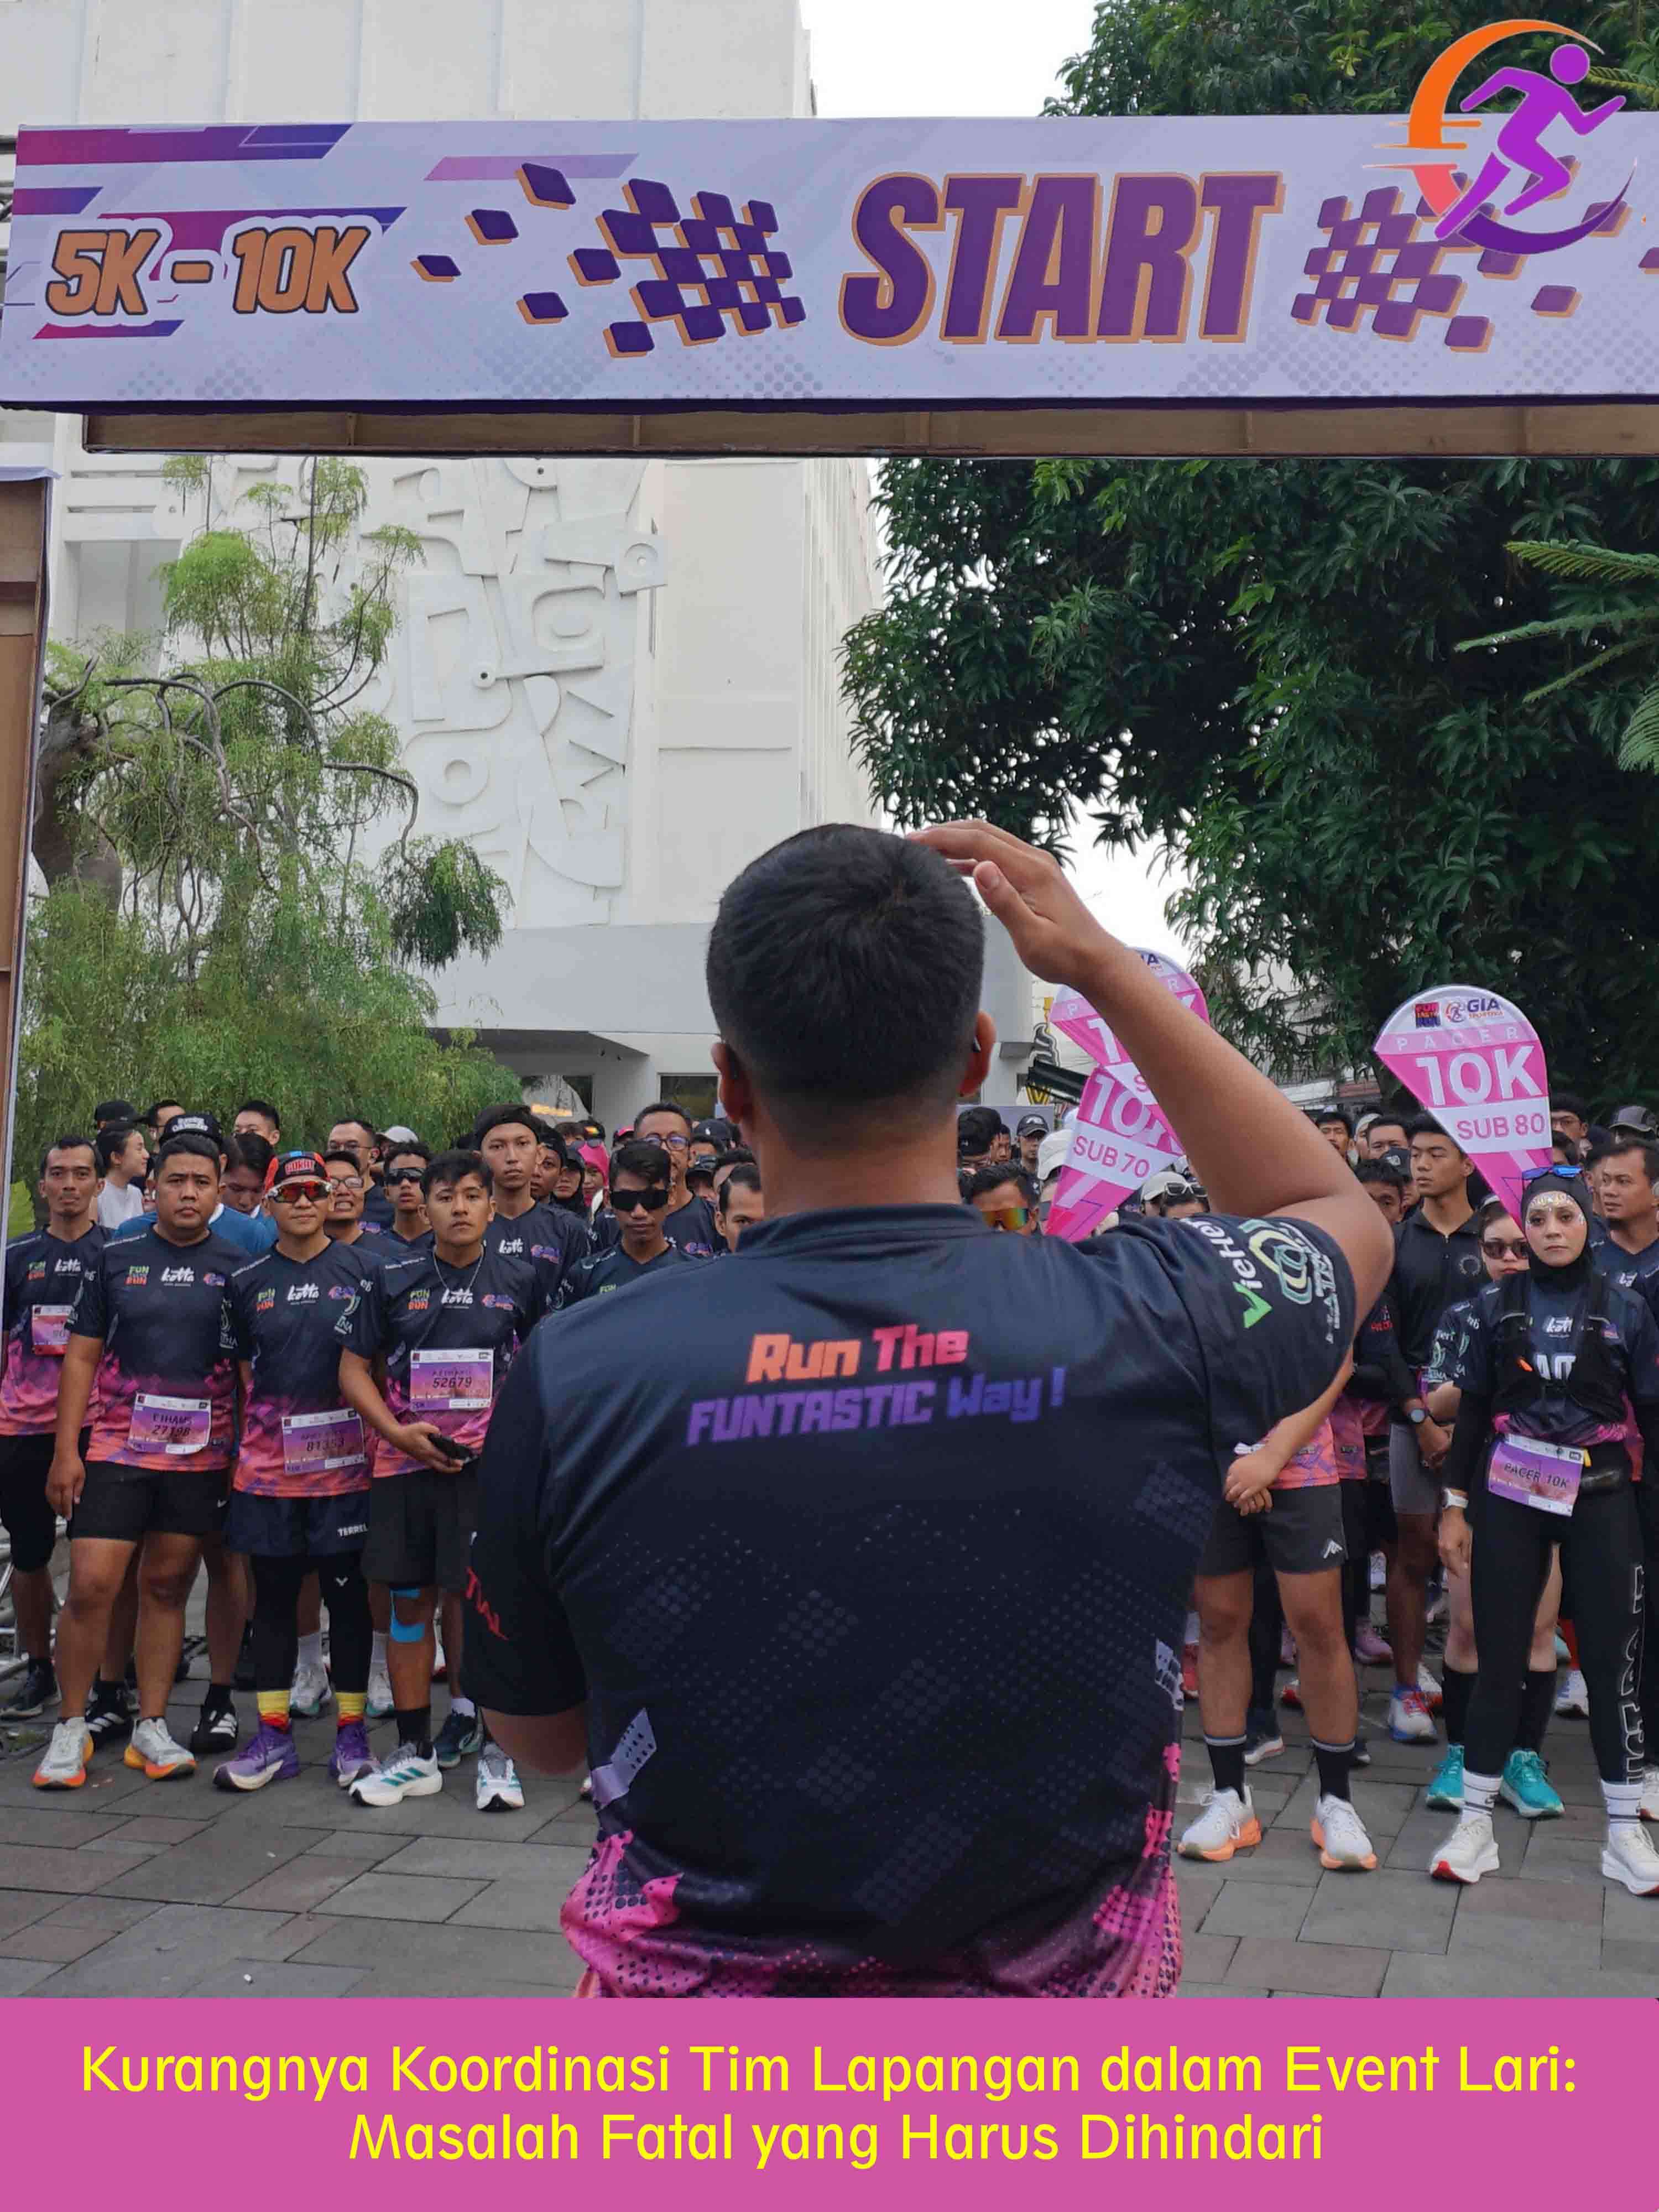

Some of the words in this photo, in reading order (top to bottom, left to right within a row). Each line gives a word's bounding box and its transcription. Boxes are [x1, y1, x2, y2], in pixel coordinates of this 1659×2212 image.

[46, 229, 161, 316] 5K
[232, 227, 371, 314] 10K
[838, 171, 1286, 346] START
[1468, 998, 1500, 1013] GIA
[1397, 1027, 1519, 1051] PACER
[1416, 1045, 1542, 1107] 10K
[1456, 1118, 1510, 1140] SUB
[1515, 1113, 1545, 1136] 80
[1073, 1135, 1118, 1167] SUB
[1120, 1152, 1150, 1178] 70
[747, 1333, 862, 1384] Run
[873, 1324, 969, 1372] The
[686, 1381, 937, 1447] FUNTASTIC
[1504, 1463, 1541, 1483] PACER
[1546, 1473, 1567, 1489] 10K
